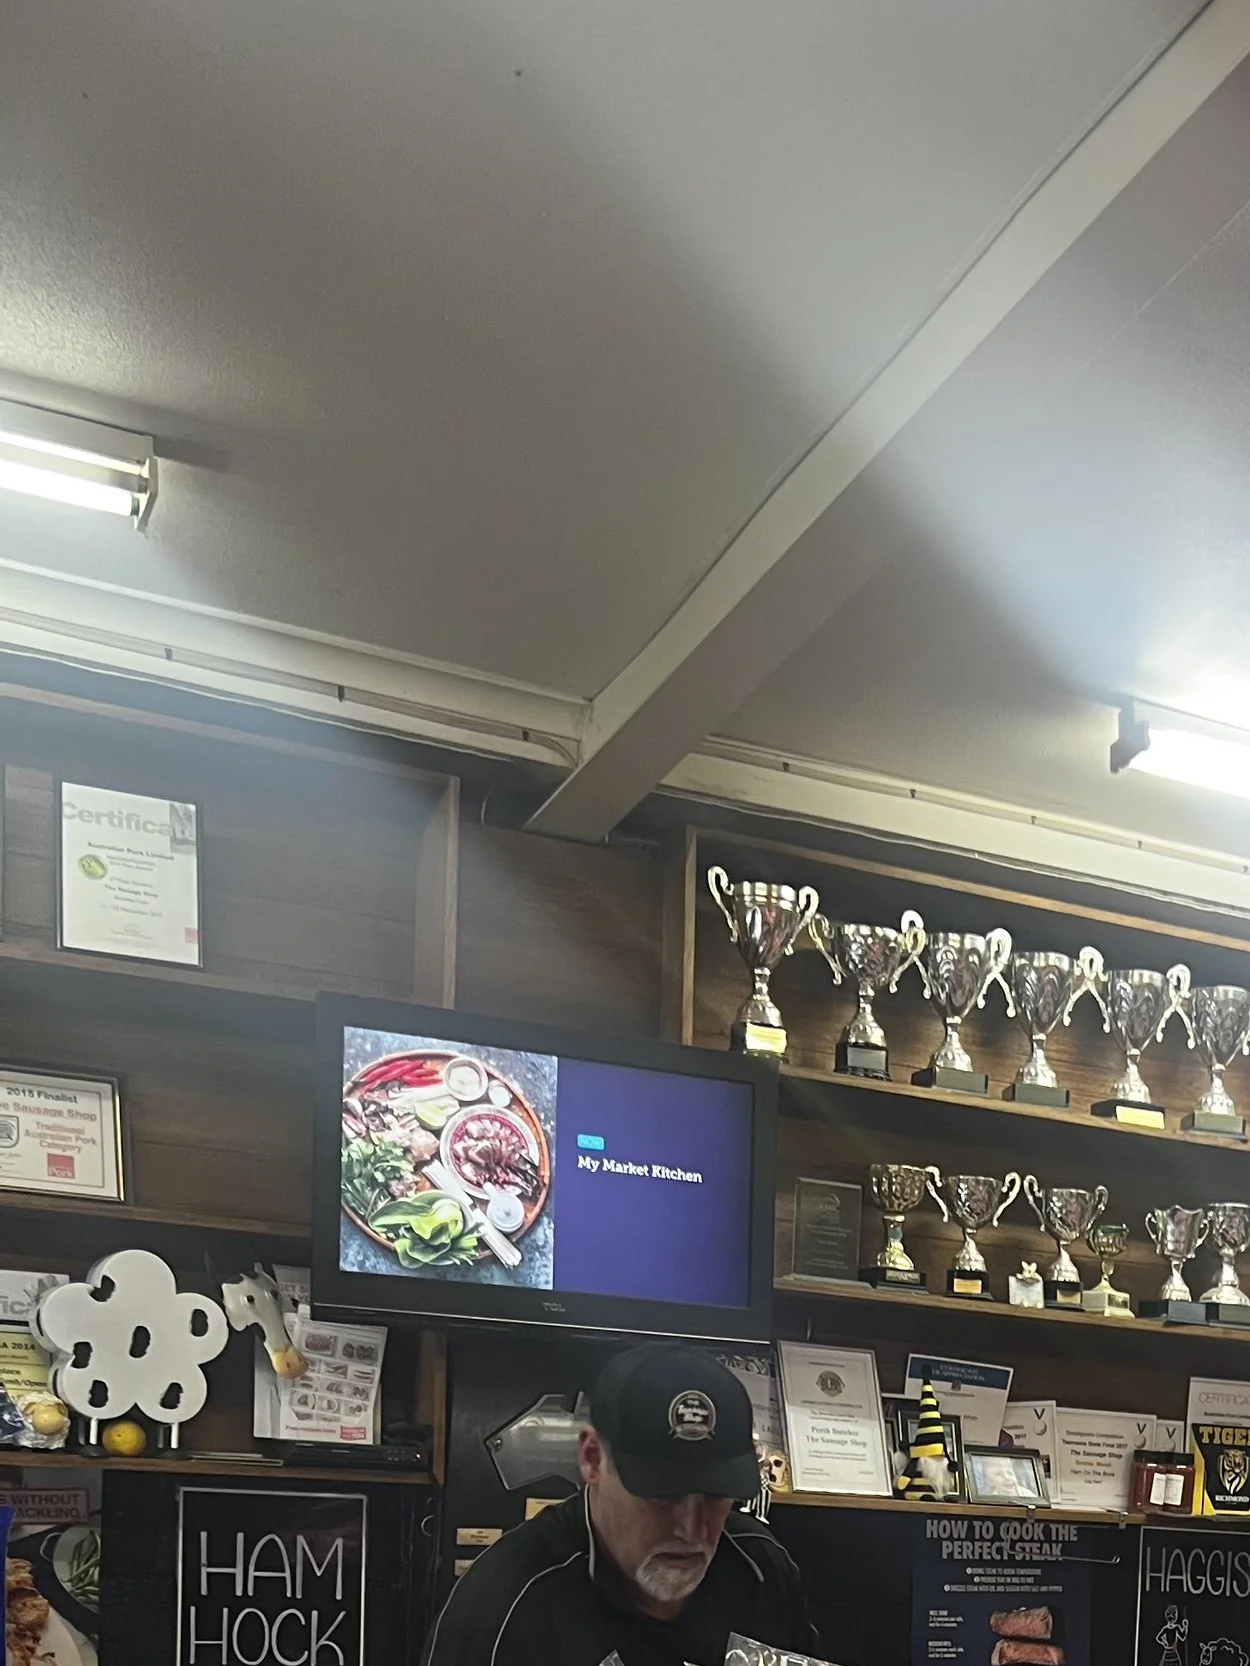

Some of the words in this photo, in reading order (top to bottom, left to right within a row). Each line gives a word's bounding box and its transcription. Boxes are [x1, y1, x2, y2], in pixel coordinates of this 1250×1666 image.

[6, 1087, 35, 1099] 2015
[37, 1090, 78, 1104] Finalist
[13, 1102, 65, 1119] Sausage
[66, 1109, 98, 1122] Shop
[36, 1121, 85, 1136] Traditional
[24, 1129, 73, 1143] Australian
[75, 1135, 97, 1146] Pork
[39, 1139, 82, 1154] Category
[577, 1155, 601, 1173] My
[602, 1158, 650, 1177] Market
[651, 1165, 703, 1184] Kitchen
[806, 1435, 819, 1444] The
[821, 1436, 849, 1447] Sausage
[850, 1439, 868, 1449] Shop
[11, 1493, 79, 1506] WITHOUT
[15, 1506, 81, 1520] ACKLING
[926, 1519, 969, 1540] HOW
[973, 1520, 995, 1540] TO
[1000, 1522, 1045, 1541] COOK
[1047, 1524, 1079, 1542] THE
[942, 1541, 1009, 1561] PERFECT
[1015, 1543, 1064, 1561] STEAK
[200, 1531, 344, 1600] HAM
[190, 1605, 346, 1666] HOCK
